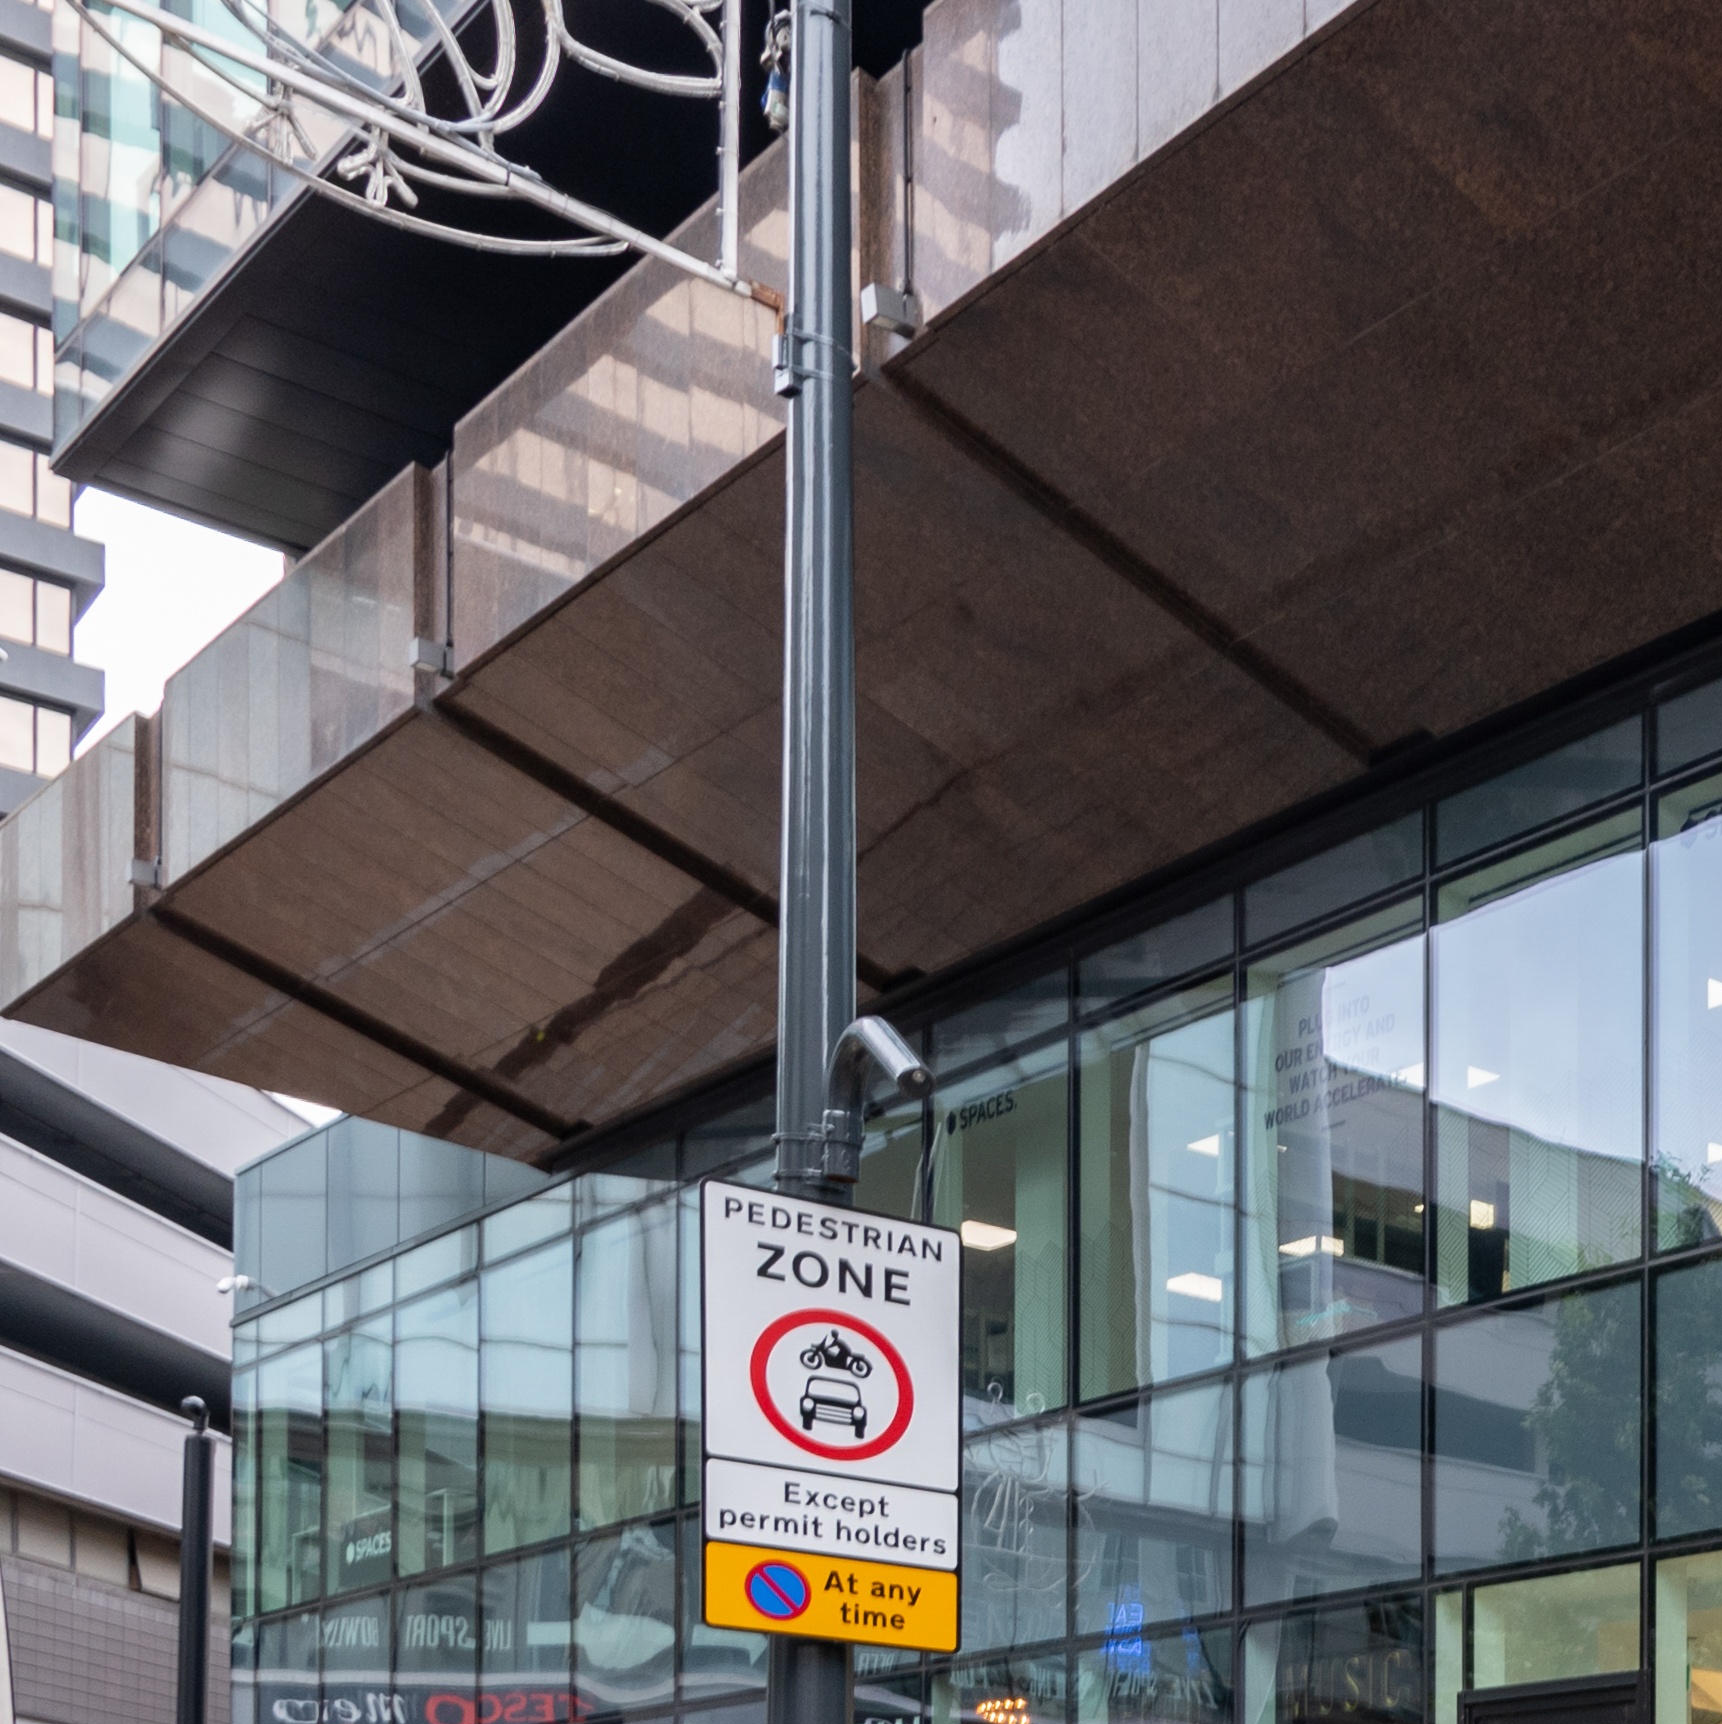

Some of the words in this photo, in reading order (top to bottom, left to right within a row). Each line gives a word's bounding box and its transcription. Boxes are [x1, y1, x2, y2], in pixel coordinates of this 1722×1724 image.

[1275, 1047, 1303, 1073] OUR
[1264, 1100, 1310, 1130] WORLD
[724, 1196, 944, 1263] PEDESTRIAN
[756, 1241, 912, 1306] ZONE
[784, 1481, 890, 1519] Except
[719, 1507, 823, 1540] permit
[835, 1521, 948, 1556] holders
[824, 1569, 859, 1597] At
[870, 1580, 922, 1608] any
[840, 1602, 906, 1631] time
